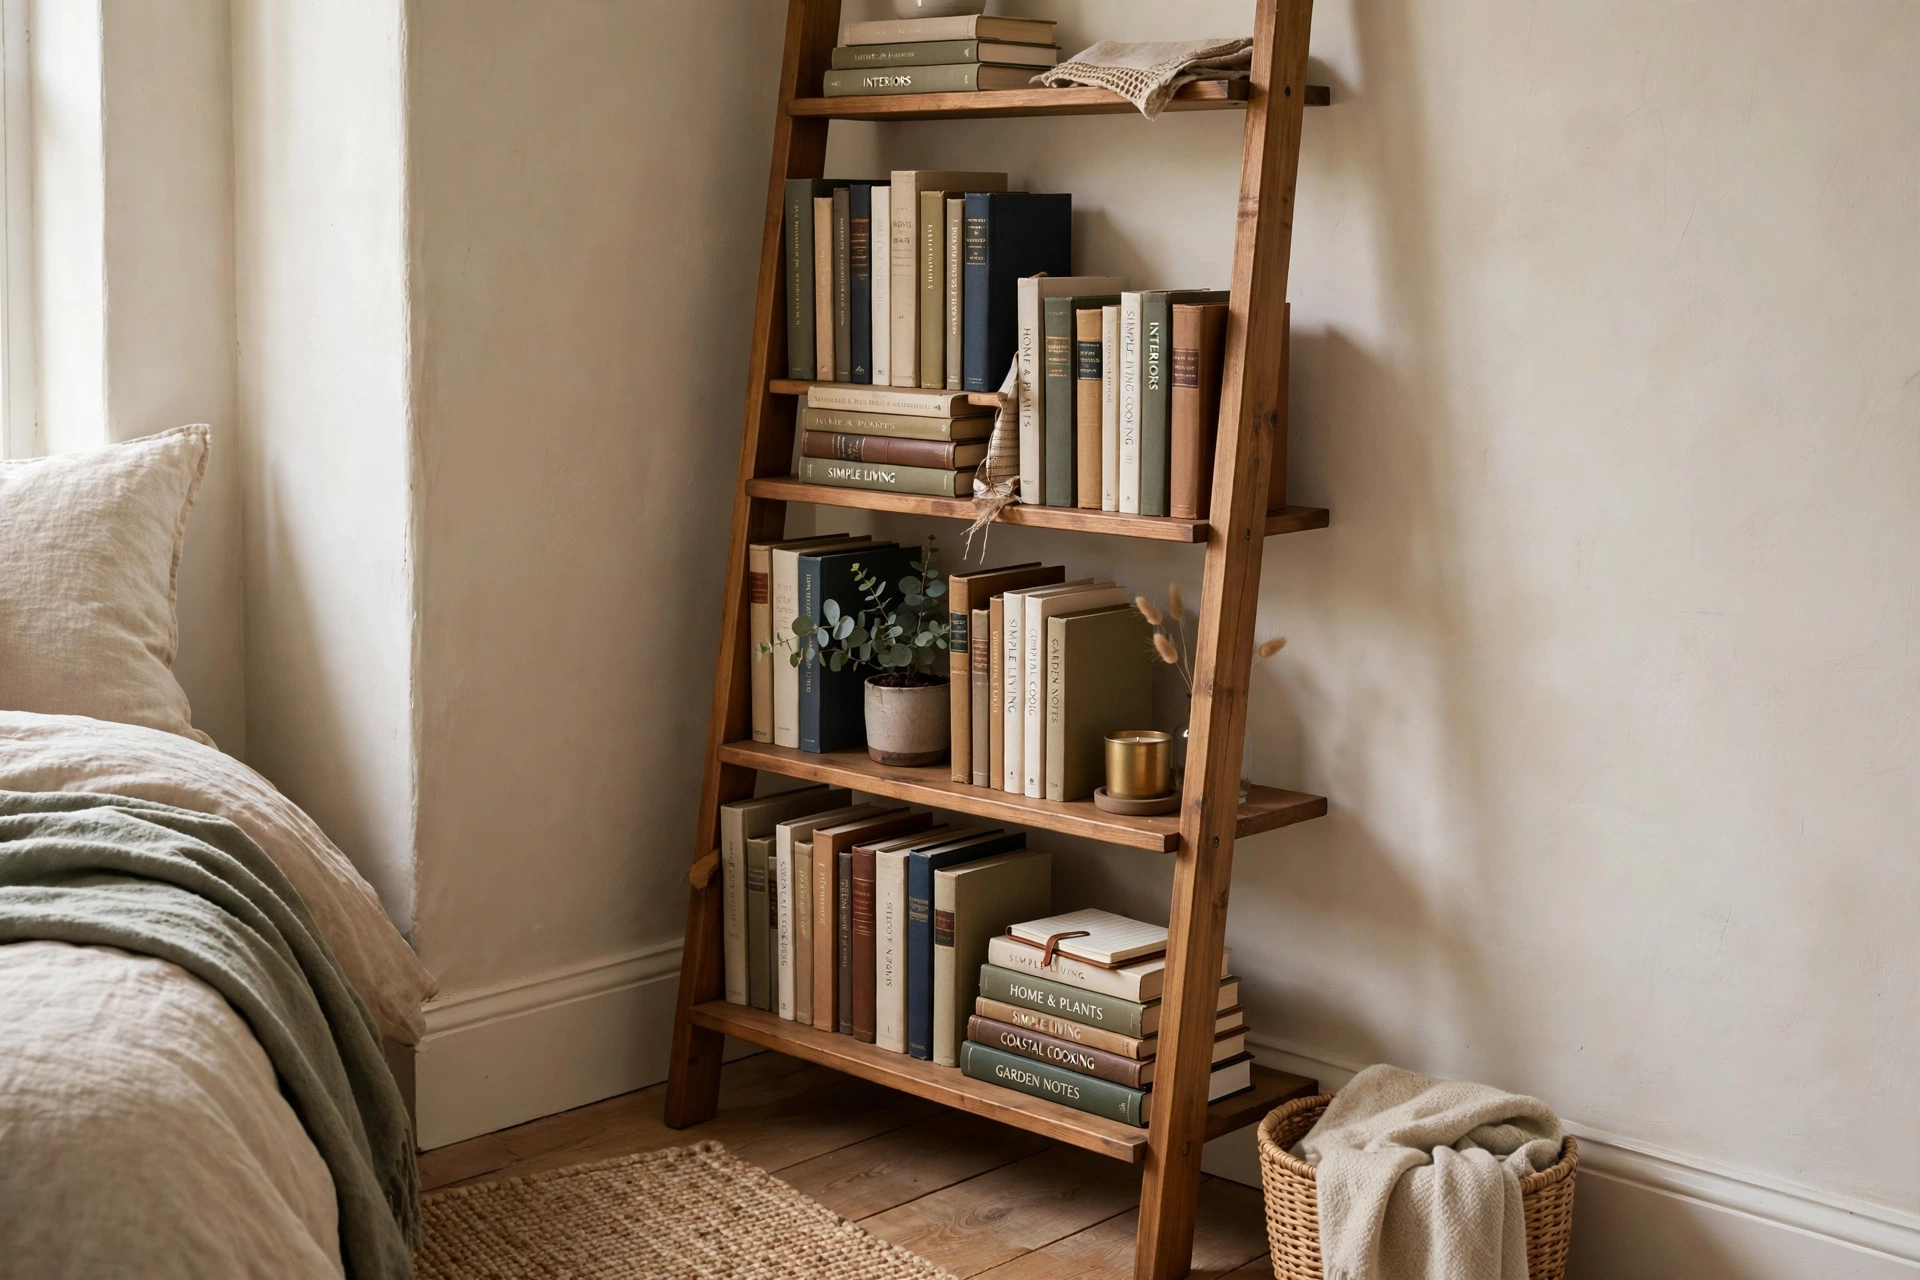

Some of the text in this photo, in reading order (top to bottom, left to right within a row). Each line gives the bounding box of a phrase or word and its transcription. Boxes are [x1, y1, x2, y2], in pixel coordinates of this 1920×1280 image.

[863, 75, 912, 88] INTERIORS
[1023, 328, 1032, 364] HOME
[1148, 321, 1159, 391] INTERIORS
[828, 467, 896, 483] SIMPLE LIVING
[1008, 618, 1017, 662] SIMPLE
[1051, 638, 1060, 684] GARDEN
[1049, 962, 1085, 980] LVING
[1010, 984, 1103, 1020] HOME & PLANTS
[1000, 1032, 1095, 1070] COASTAL COOKING
[995, 1064, 1080, 1100] GARDEN NOTES
